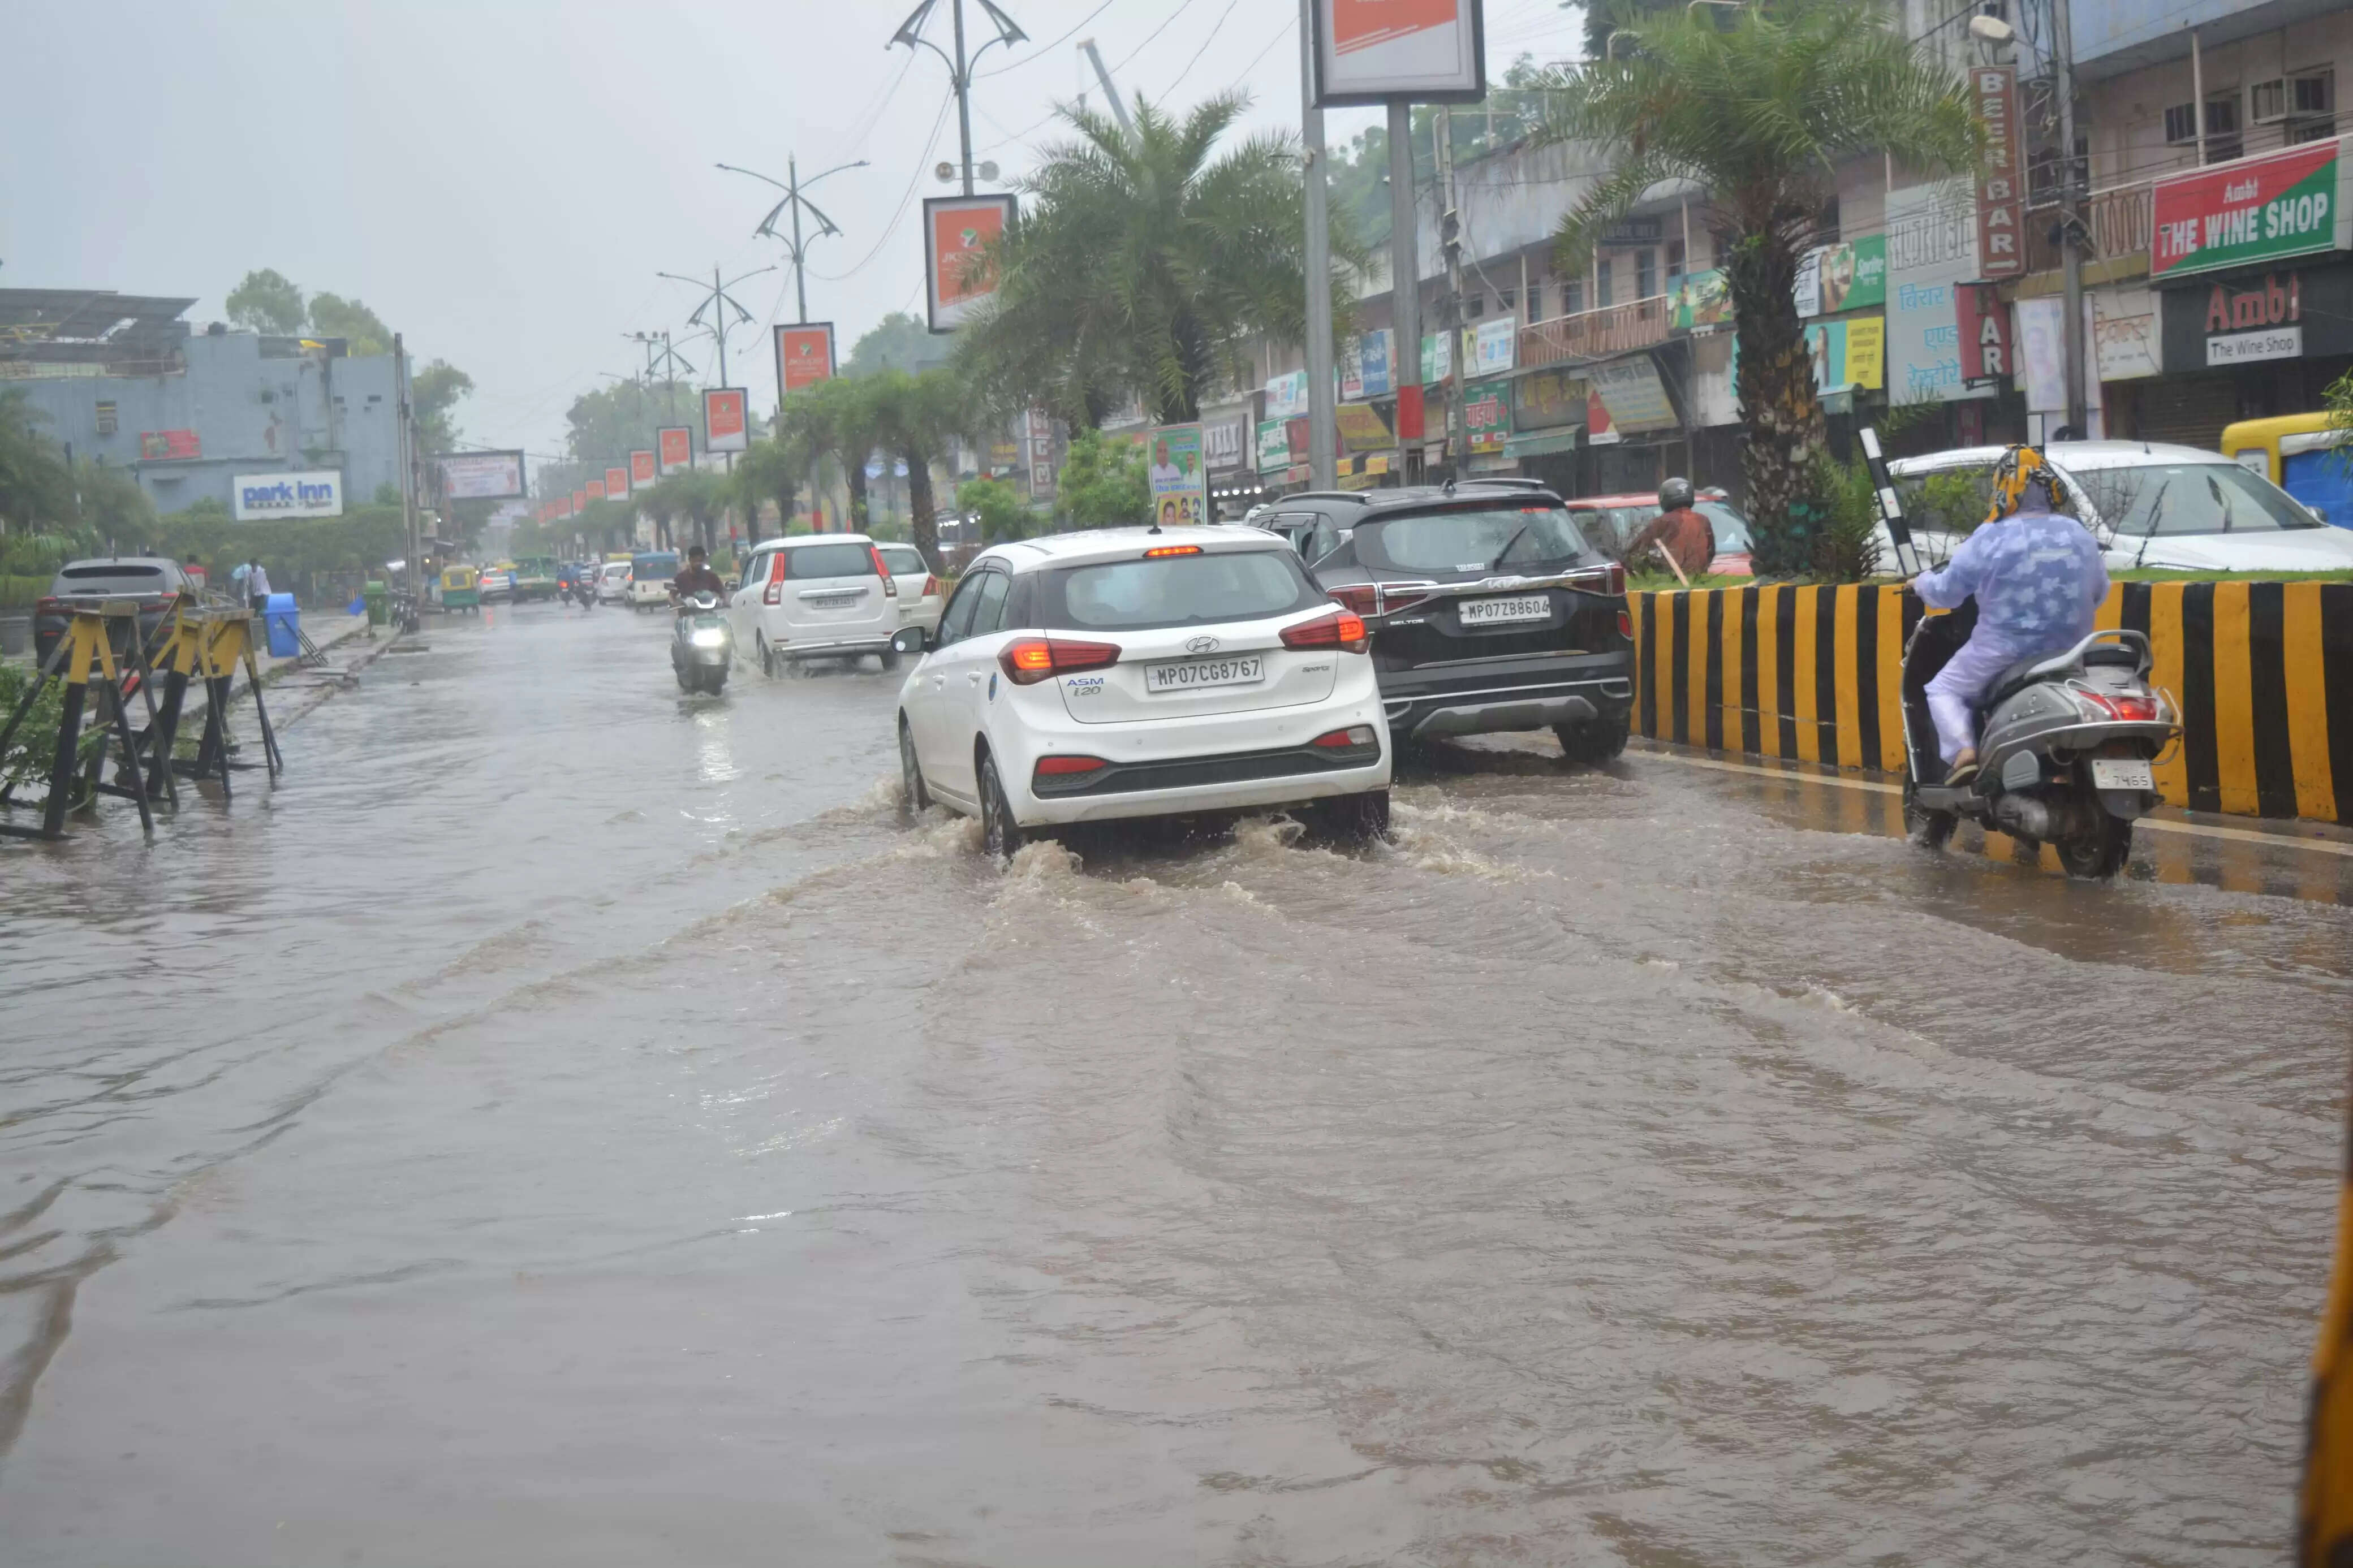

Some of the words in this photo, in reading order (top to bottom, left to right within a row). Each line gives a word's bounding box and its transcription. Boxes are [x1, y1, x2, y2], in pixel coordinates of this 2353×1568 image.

[1980, 73, 2006, 168] BEER
[1987, 180, 2014, 254] BAR
[2160, 218, 2199, 258] THE
[2205, 206, 2260, 249] WINE
[2265, 192, 2328, 239] SHOP
[2211, 342, 2233, 359] The
[2235, 340, 2264, 356] Wine
[2266, 336, 2295, 355] Shop
[243, 482, 294, 509] park
[297, 481, 332, 500] inn
[1067, 677, 1104, 686] ASM
[1158, 659, 1259, 685] MP07CG8767
[1074, 686, 1101, 696] i20
